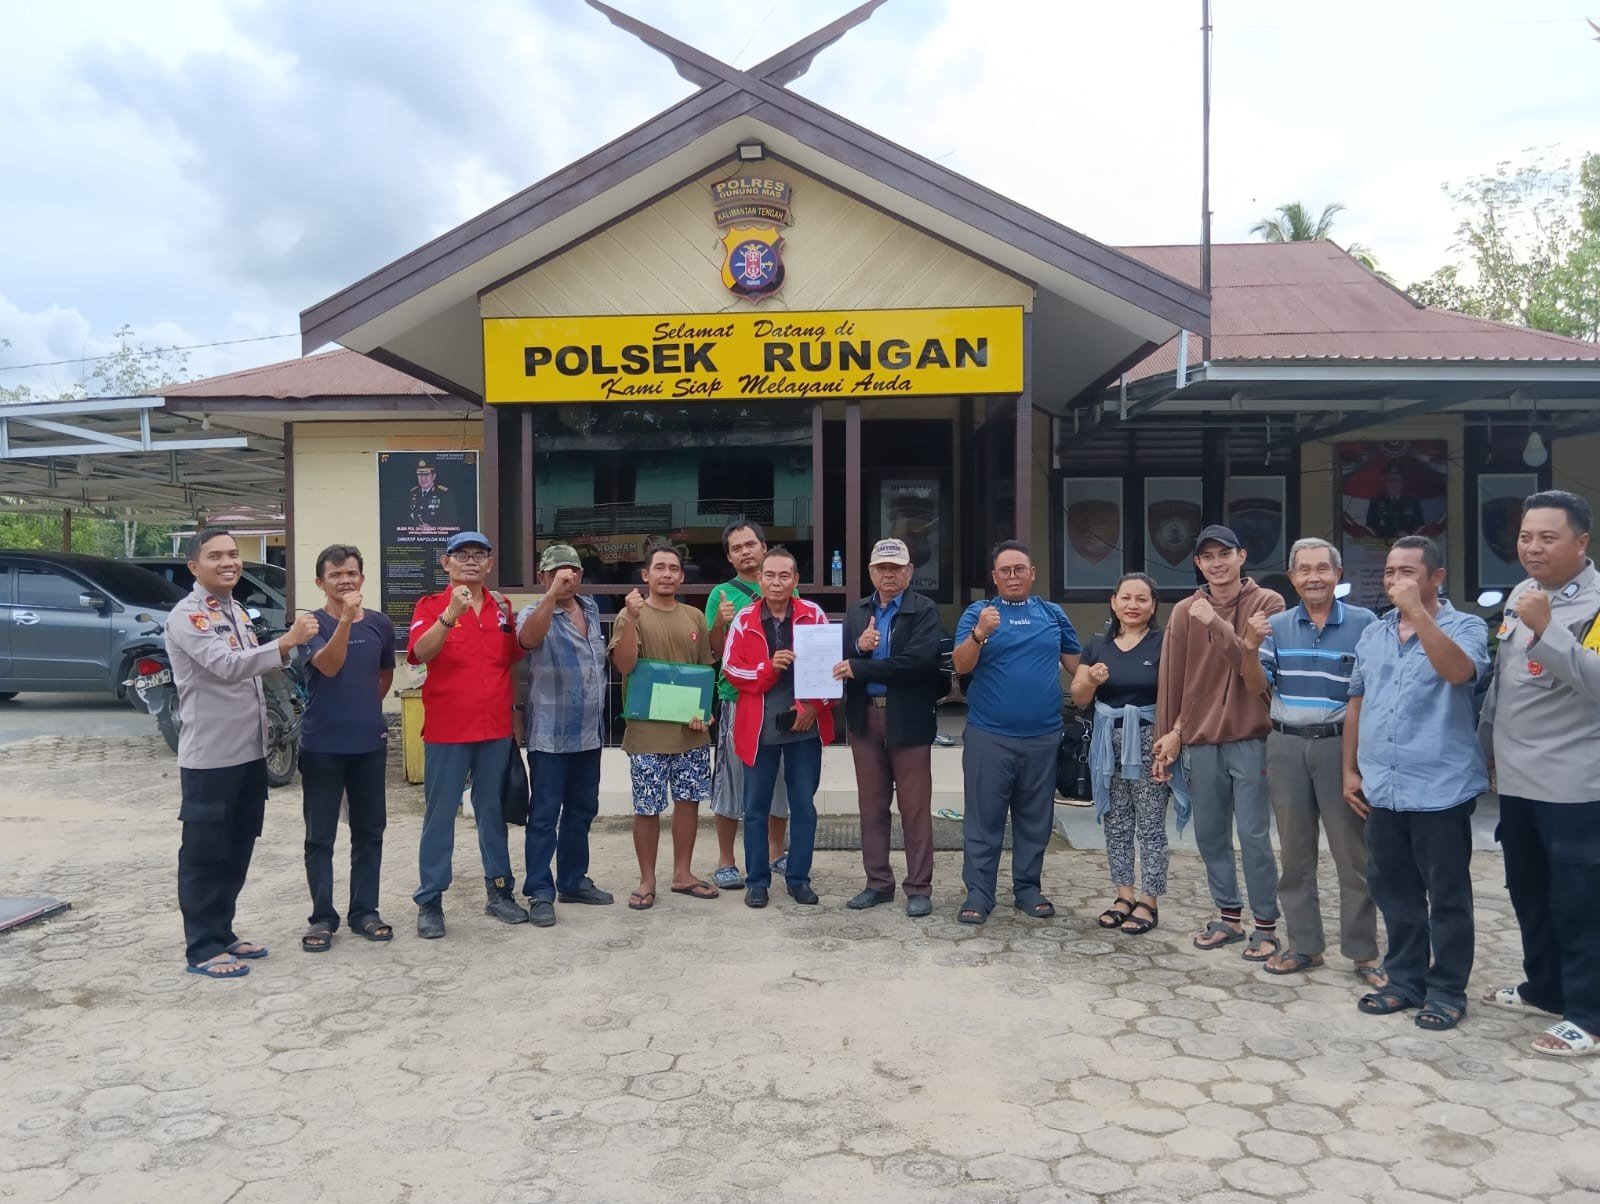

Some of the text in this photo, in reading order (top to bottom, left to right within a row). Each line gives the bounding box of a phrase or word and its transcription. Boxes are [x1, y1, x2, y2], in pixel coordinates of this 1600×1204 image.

[716, 178, 785, 193] POLRES
[720, 188, 782, 199] GUNUNG MAS
[717, 207, 784, 221] KALIMANTAN TENGAH
[652, 319, 856, 342] Selamat Datang di
[524, 337, 989, 377] POLSEK RUNGAN
[600, 372, 913, 400] Kami Siap Melayani Anda
